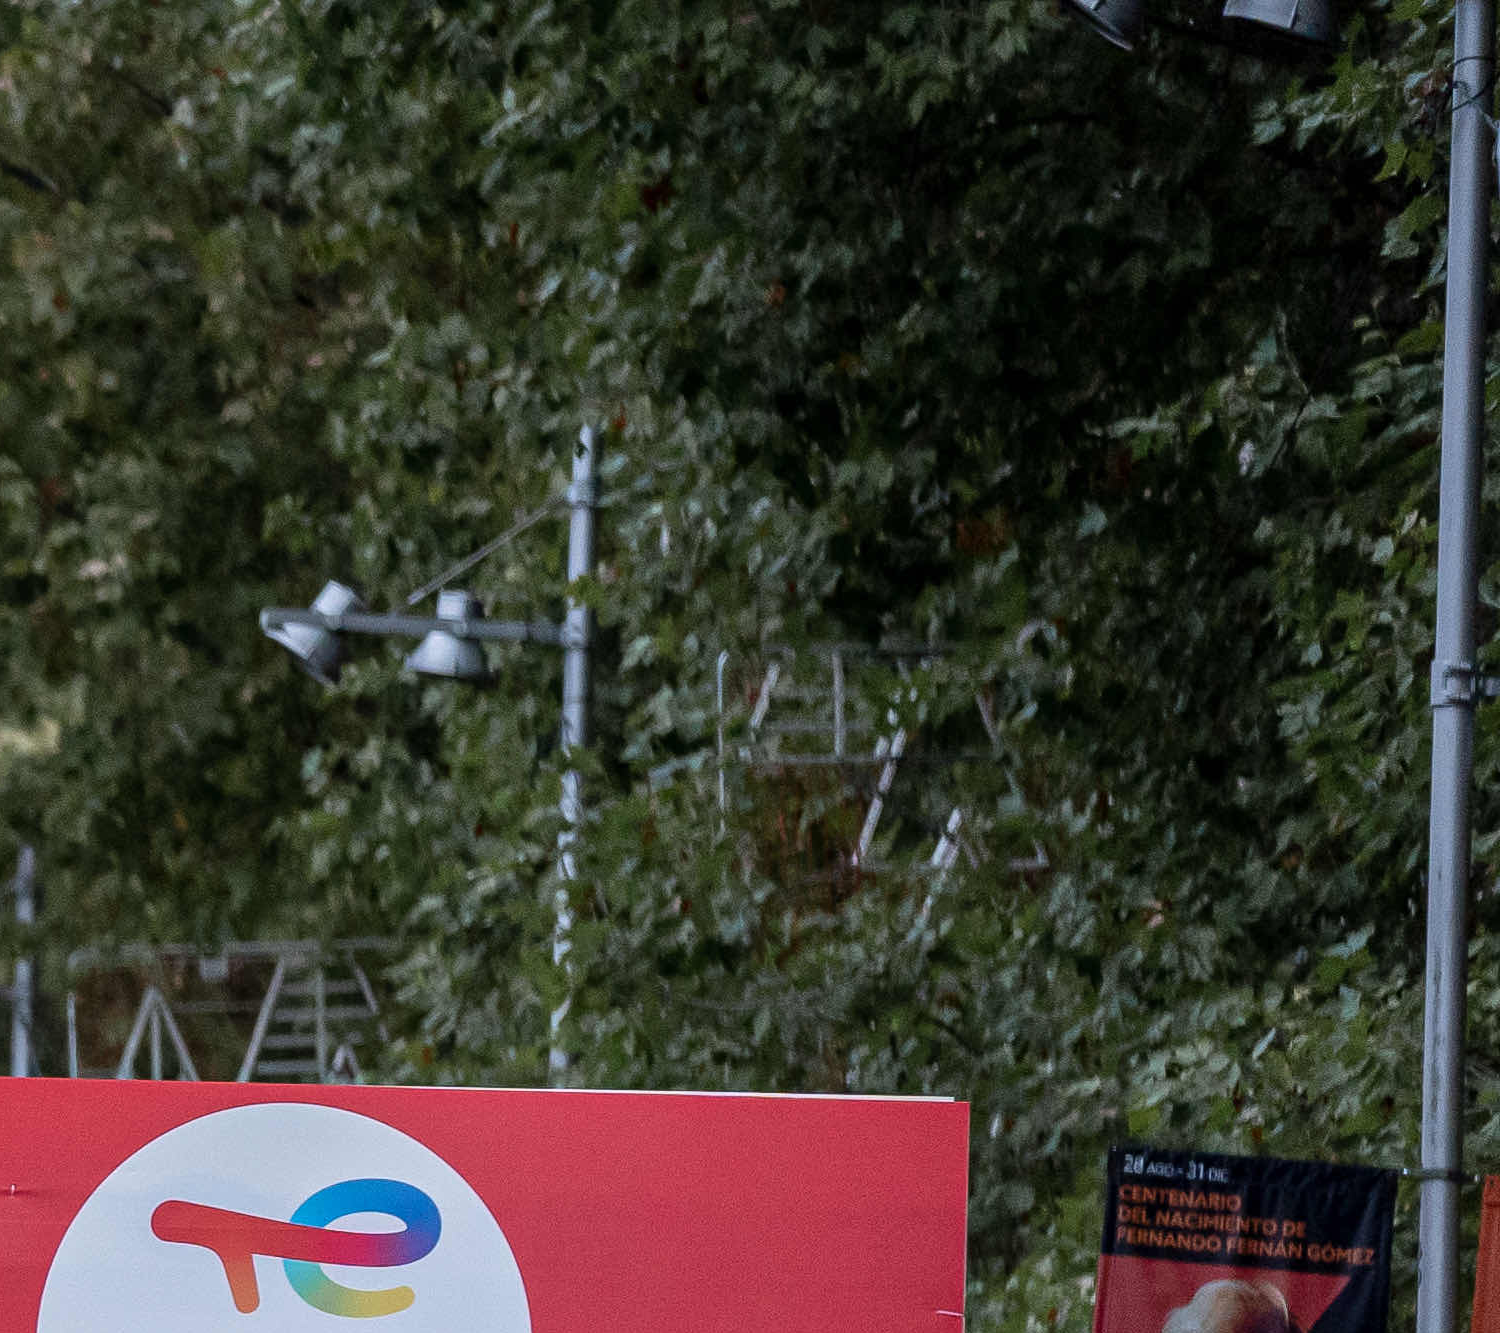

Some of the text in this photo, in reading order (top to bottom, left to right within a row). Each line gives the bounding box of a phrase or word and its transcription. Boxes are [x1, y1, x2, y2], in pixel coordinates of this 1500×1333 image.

[1118, 1184, 1242, 1212] CENTENARIO
[1116, 1205, 1307, 1239] DEL NACIMIENTO DE
[1116, 1224, 1222, 1252] FERNANDO
